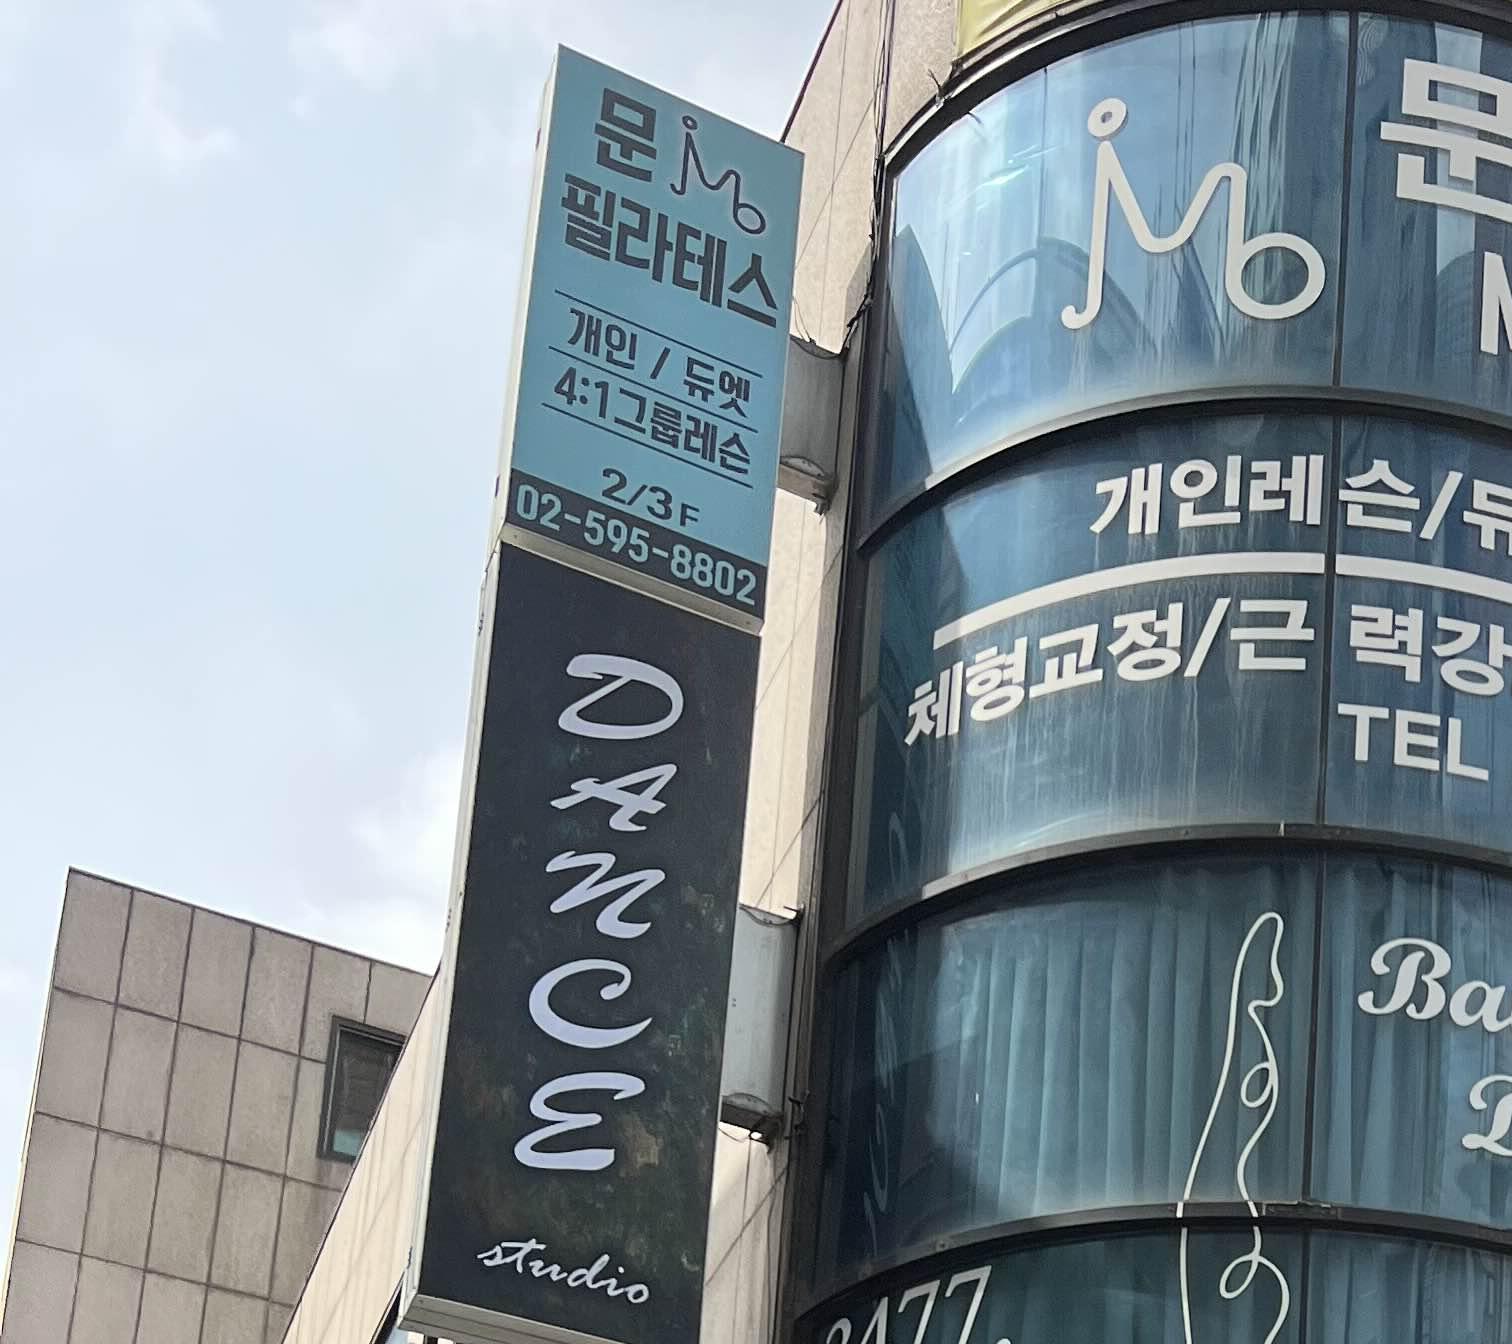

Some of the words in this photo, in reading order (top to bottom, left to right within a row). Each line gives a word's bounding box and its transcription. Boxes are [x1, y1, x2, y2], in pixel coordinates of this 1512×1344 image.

[594, 88, 657, 183] 문
[561, 173, 777, 328] 필라테스
[601, 467, 700, 528] 2/3F
[516, 484, 758, 607] 02-595-8802
[1336, 701, 1490, 781] TEL
[513, 653, 685, 1171] DANCE
[478, 1237, 651, 1306] studio
